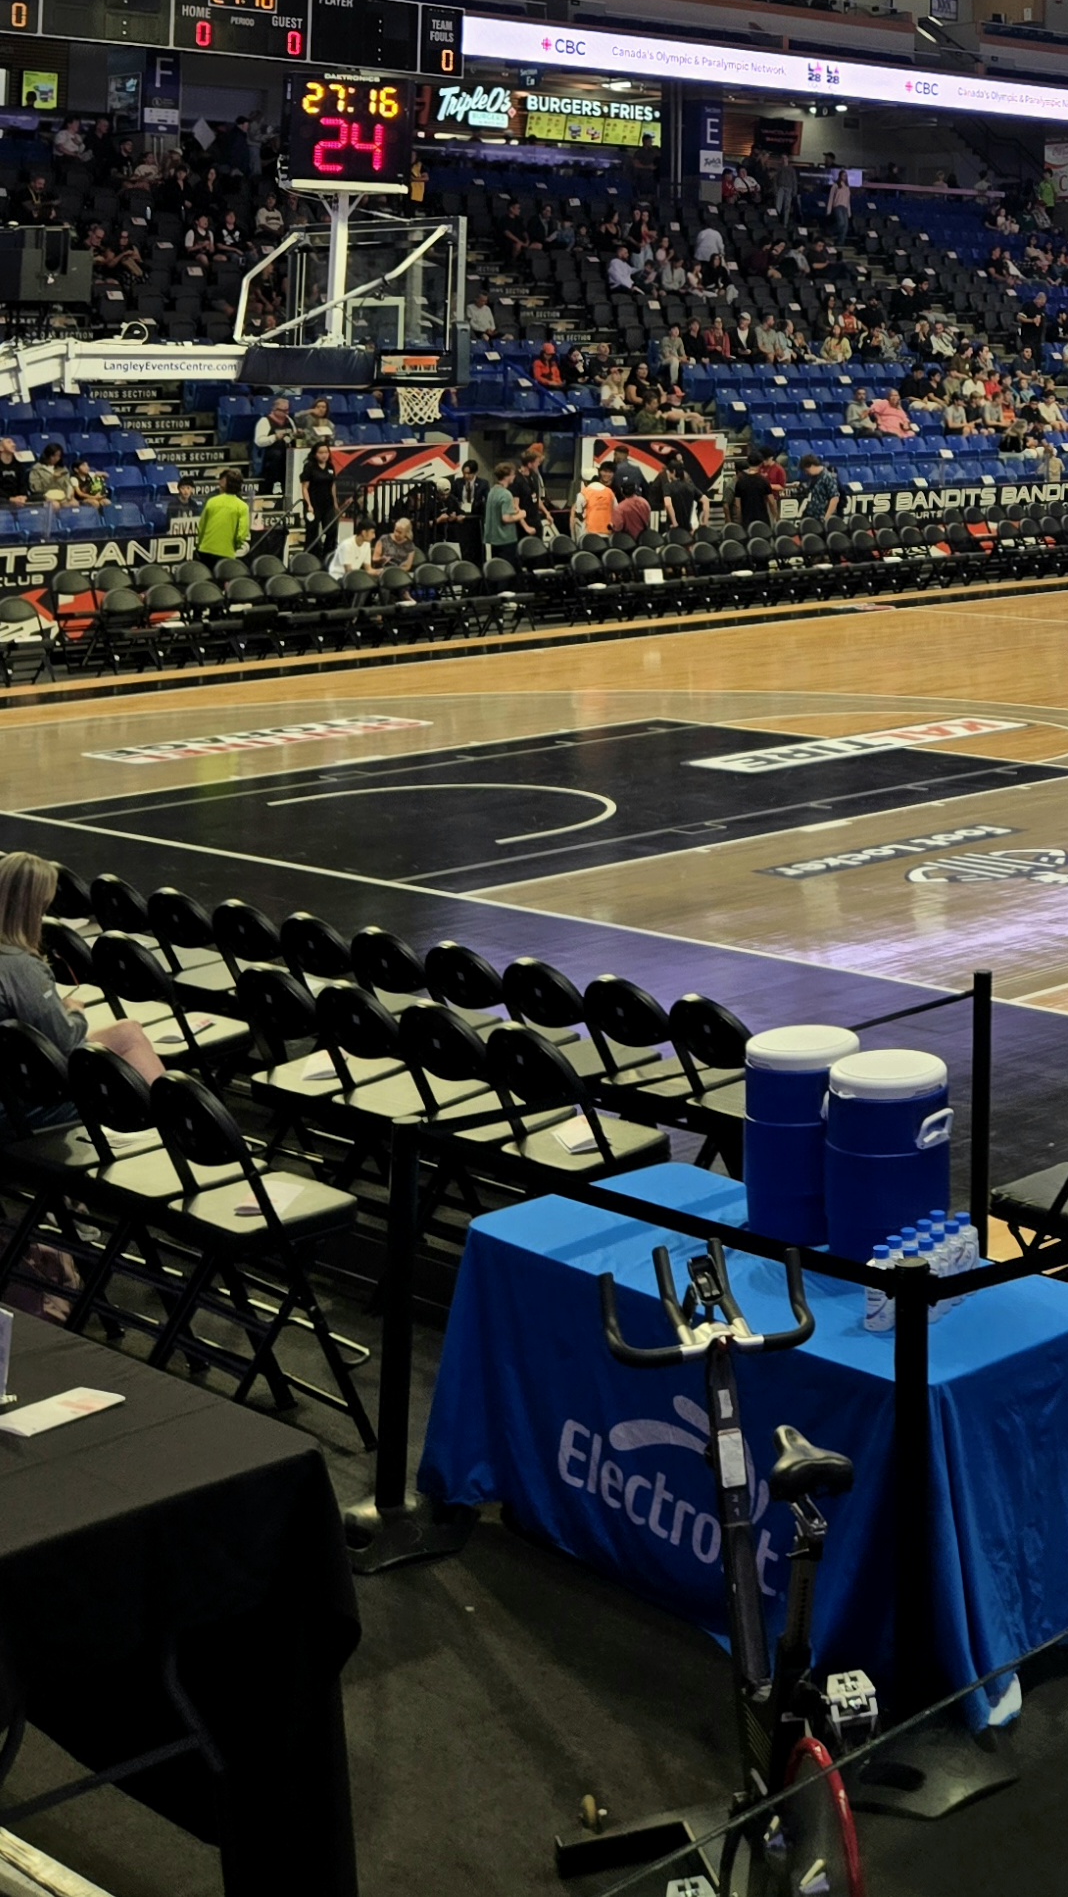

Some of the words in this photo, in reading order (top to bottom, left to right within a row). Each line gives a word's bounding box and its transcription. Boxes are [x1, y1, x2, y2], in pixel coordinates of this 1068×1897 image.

[11, 2, 27, 28] 0
[181, 5, 212, 19] HOME
[230, 16, 255, 27] PERIOD
[272, 15, 303, 29] GUEST
[195, 21, 212, 47] 0
[431, 19, 453, 31] TEAM
[286, 30, 303, 55] 0
[430, 31, 454, 43] FOULS
[440, 49, 454, 71] 0
[555, 38, 586, 56] CBC
[612, 46, 654, 61] Canada's
[656, 51, 692, 65] Olympic
[694, 56, 700, 65] &
[702, 57, 749, 71] Paralympic
[751, 62, 786, 76] Network
[155, 57, 174, 88] F
[324, 73, 380, 83] DAKTRONICS
[808, 72, 821, 82] 28
[827, 74, 840, 84] 28
[302, 81, 399, 118] 27:16
[915, 81, 939, 96] CBC
[526, 95, 603, 117] BURGERS
[610, 104, 653, 121] FRIES
[706, 118, 720, 144] E
[313, 116, 385, 174] 24
[104, 361, 237, 372] LangleyEventsCentre.com
[121, 388, 157, 399] SECTION
[156, 418, 190, 429] SECTION
[189, 451, 225, 460] SECTION
[895, 487, 997, 511] BANDITS
[864, 719, 994, 742] KAL
[724, 739, 896, 770] TIRE
[910, 825, 1012, 847] Foot
[775, 839, 924, 876] Locker
[557, 1418, 779, 1597] Electrot
